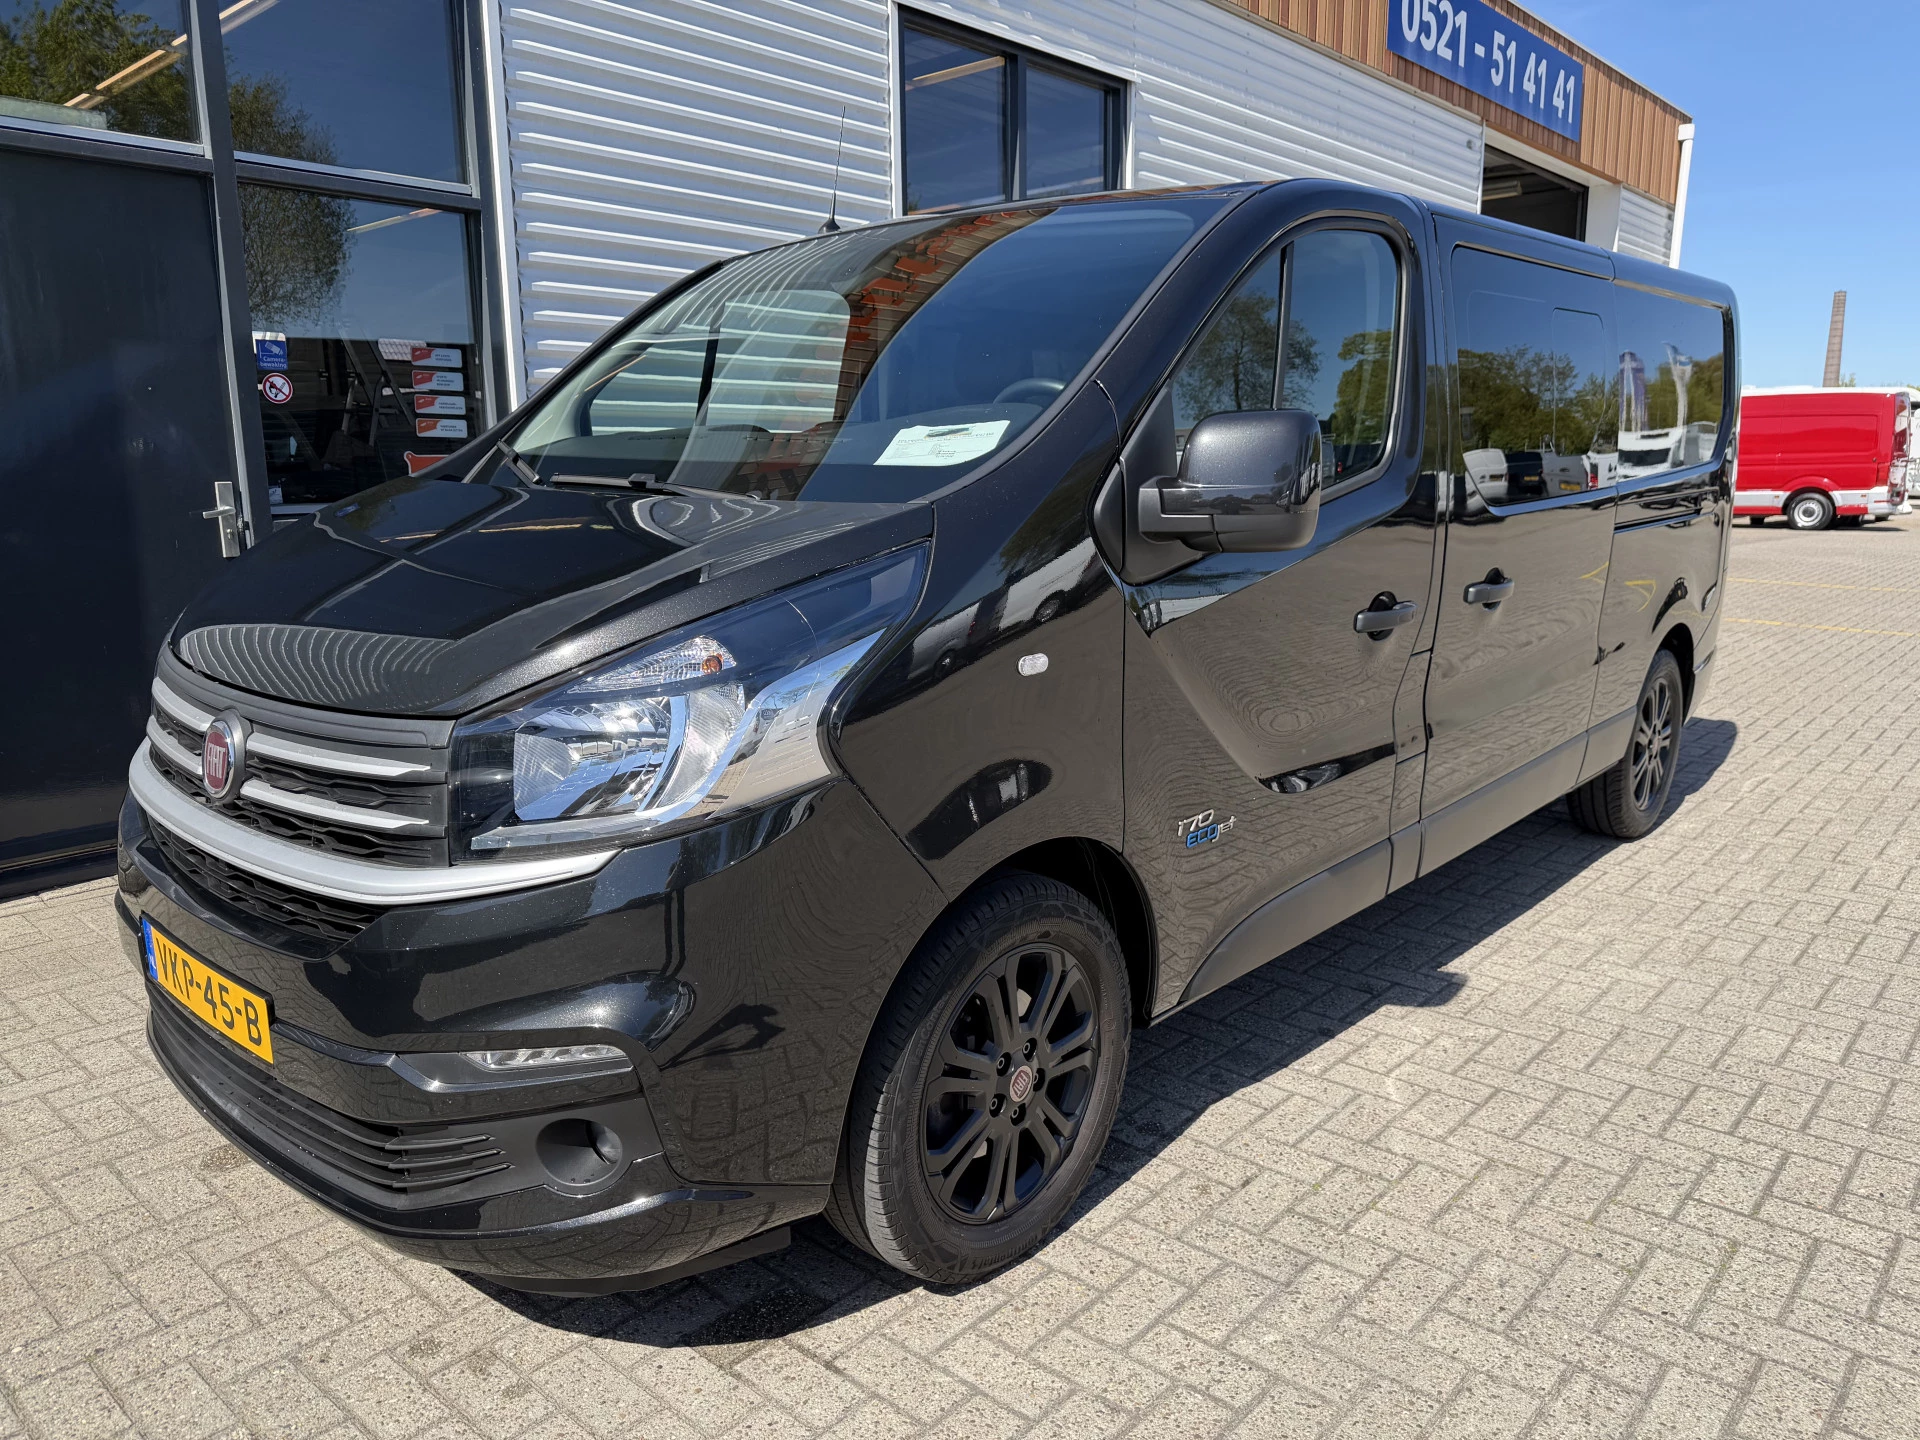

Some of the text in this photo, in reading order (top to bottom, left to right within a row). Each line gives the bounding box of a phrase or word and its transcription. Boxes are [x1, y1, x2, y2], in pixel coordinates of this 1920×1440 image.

[1401, 0, 1468, 68] 0521
[1490, 30, 1517, 94] 51
[1522, 51, 1547, 109] 41
[1552, 69, 1575, 124] 41
[259, 361, 287, 369] bewaking
[207, 742, 226, 778] FIAT
[1177, 808, 1215, 837] 170
[155, 936, 262, 1047] VKP-45-B
[1012, 1072, 1029, 1097] FIAT
